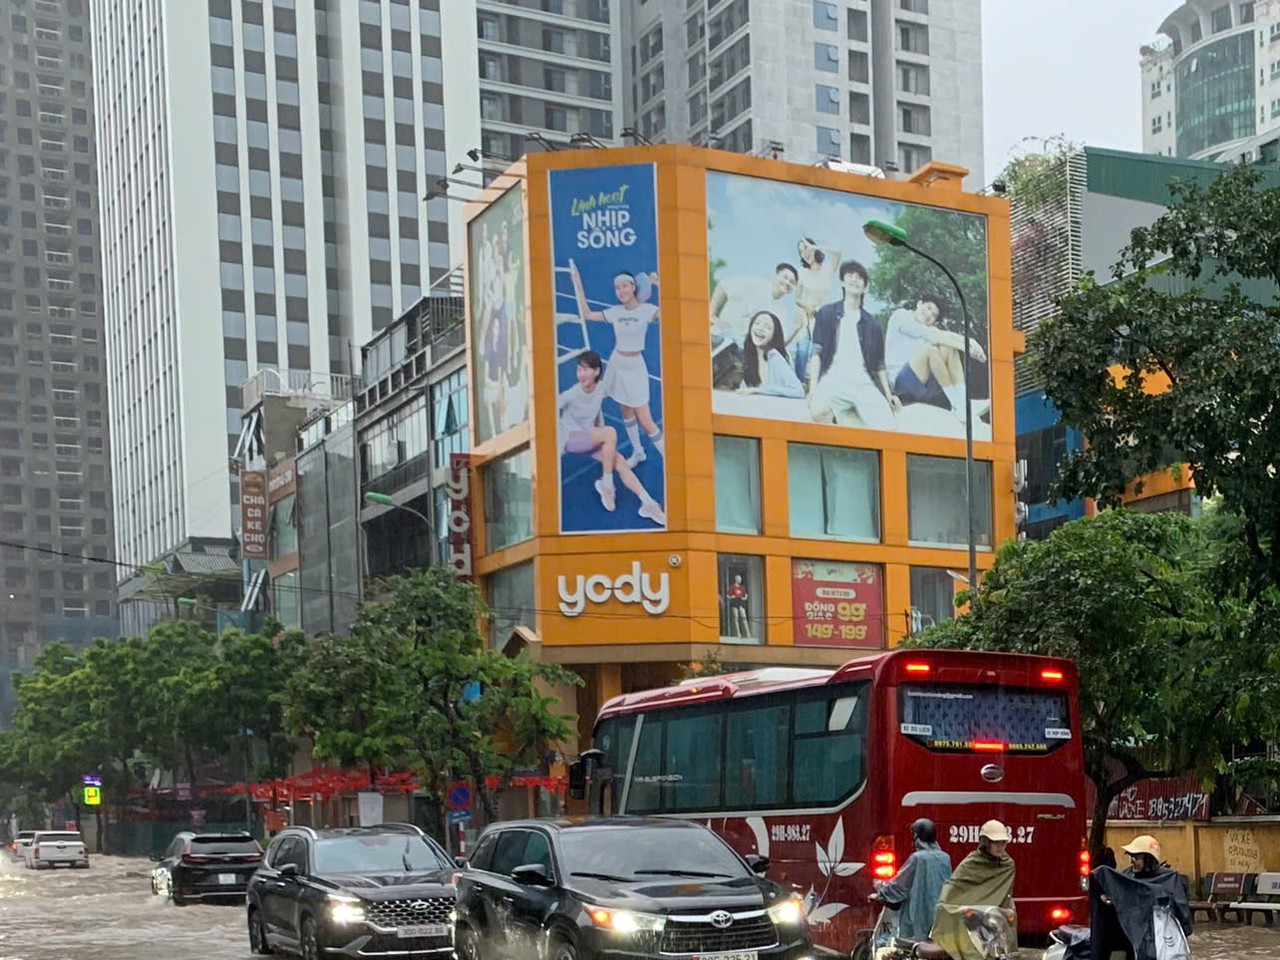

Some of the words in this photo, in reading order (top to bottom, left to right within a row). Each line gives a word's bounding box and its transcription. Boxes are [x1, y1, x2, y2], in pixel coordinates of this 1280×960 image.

[582, 210, 631, 230] NHỊP
[445, 467, 472, 576] yod
[557, 560, 670, 617] yody
